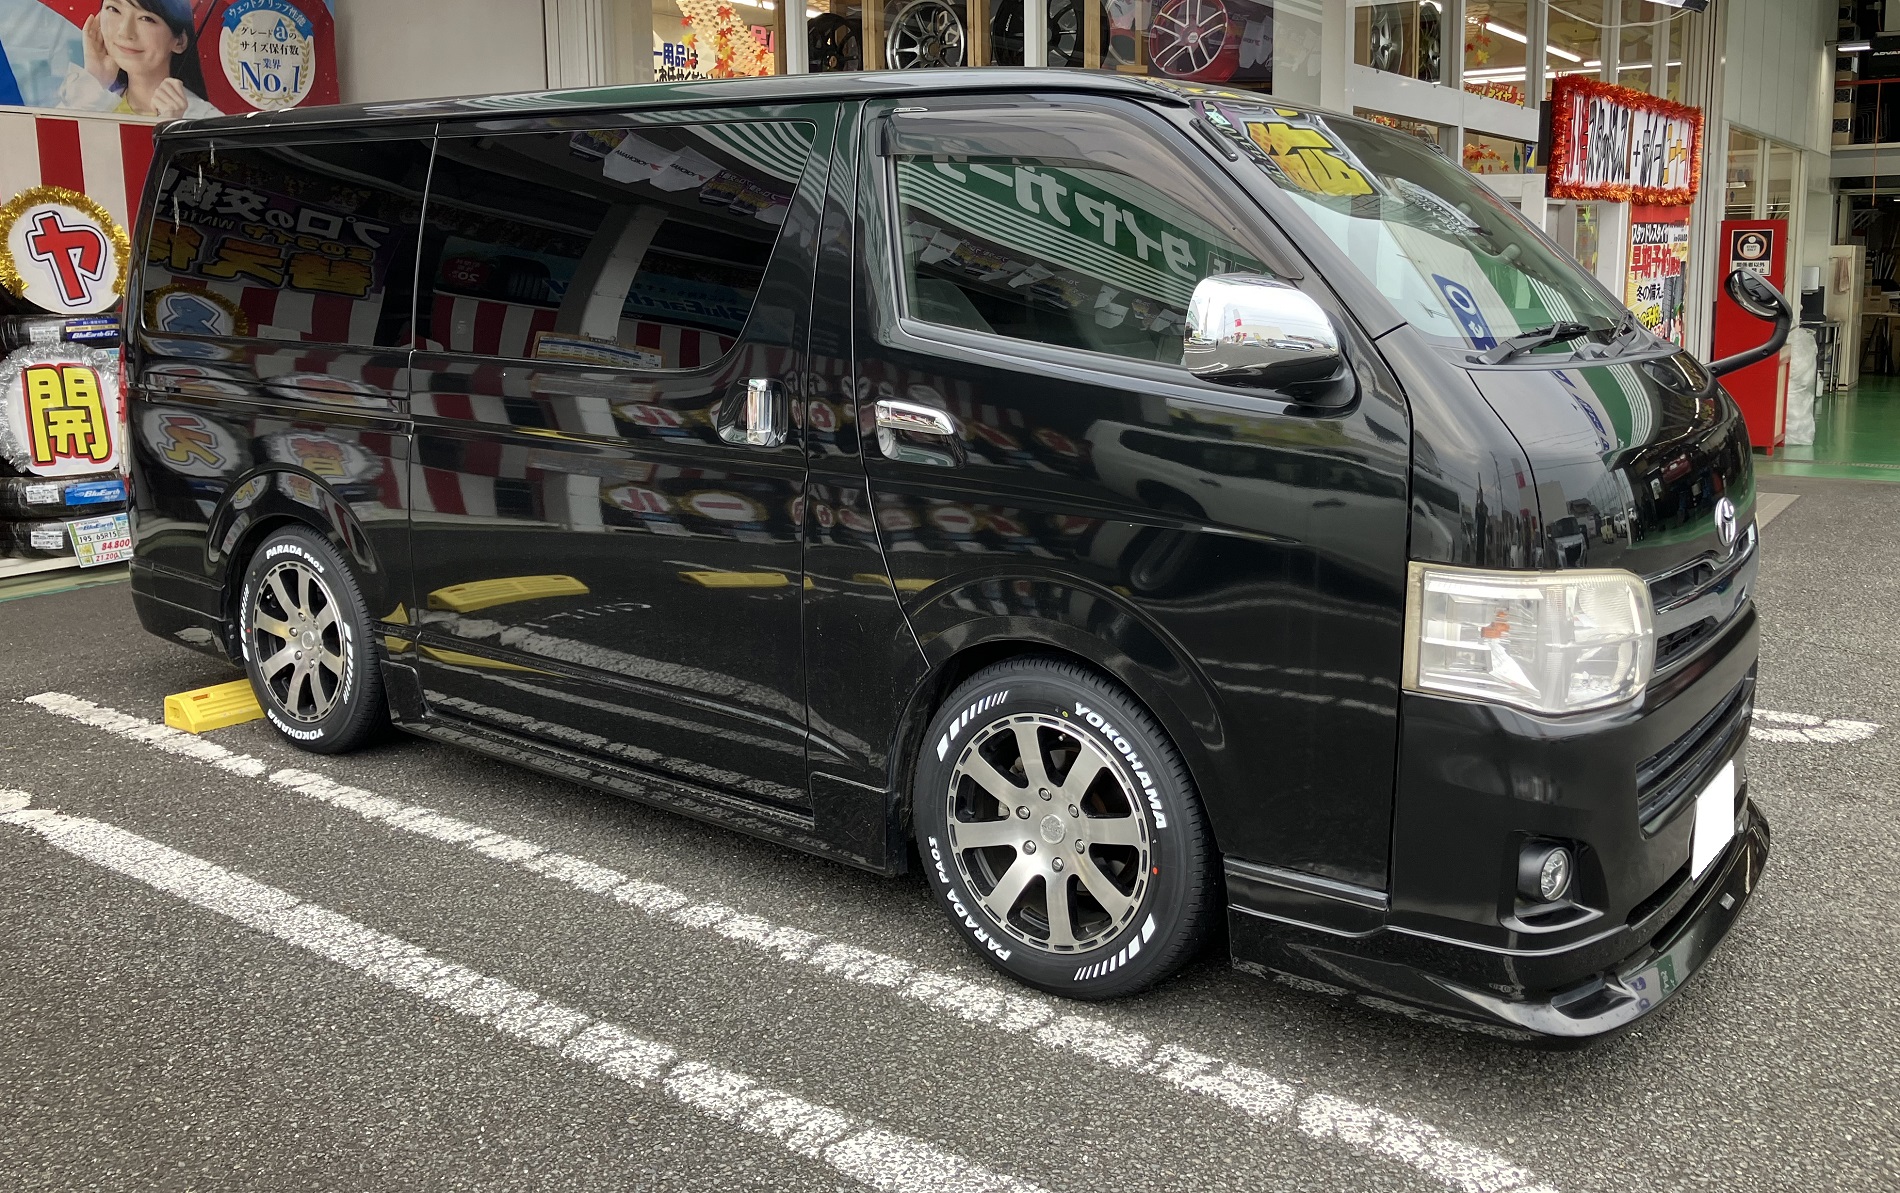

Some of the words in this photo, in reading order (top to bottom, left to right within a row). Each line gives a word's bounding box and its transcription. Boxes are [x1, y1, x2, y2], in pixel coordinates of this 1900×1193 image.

[240, 41, 299, 56] サイズ保有数
[238, 60, 301, 94] No.1
[30, 214, 104, 303] ヤ
[24, 365, 111, 465] 開
[266, 544, 303, 560] PARADA
[266, 708, 325, 741] YOKOHAMA
[1073, 701, 1167, 829] YOKOHAMA
[946, 888, 1012, 962] PARADA
